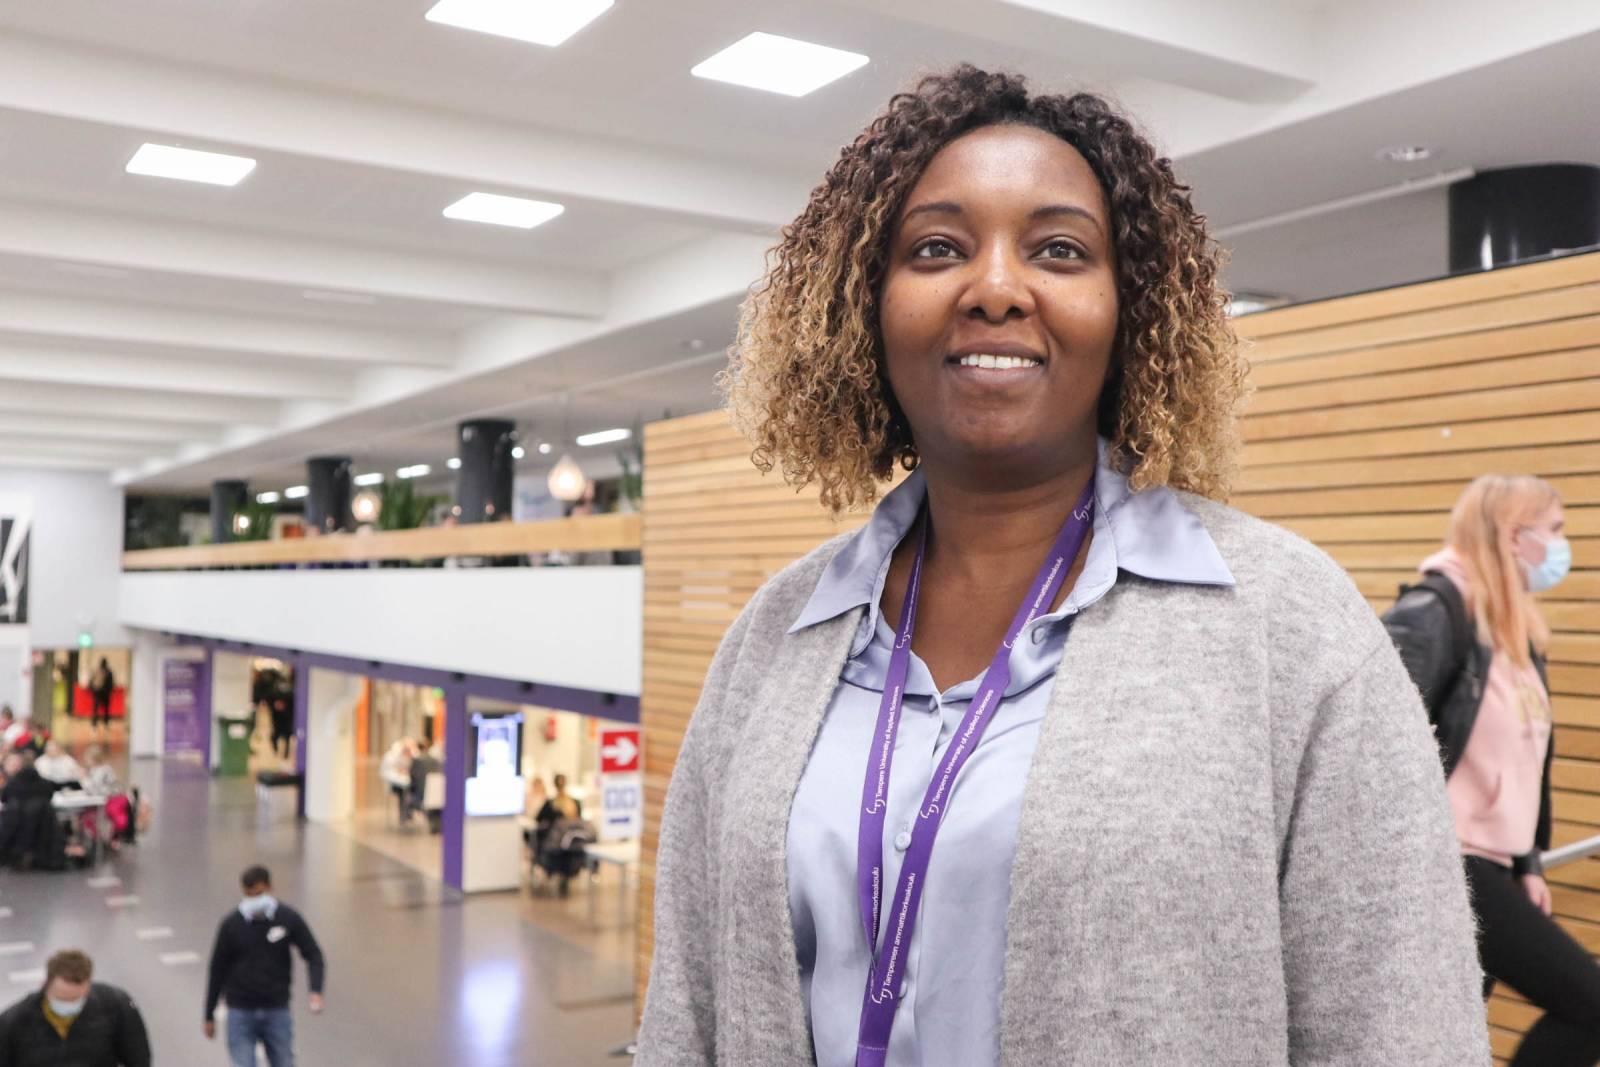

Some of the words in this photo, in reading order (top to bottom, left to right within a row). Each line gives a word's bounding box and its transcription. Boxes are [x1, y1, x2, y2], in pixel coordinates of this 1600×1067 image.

[890, 686, 899, 711] Sciences
[886, 711, 895, 733] Applied
[879, 740, 891, 770] University
[932, 774, 949, 802] Tampere
[945, 744, 964, 774] University
[960, 736, 967, 744] of
[964, 715, 980, 738] Applied
[975, 689, 994, 716] Sciences
[876, 770, 885, 798] Tampere
[883, 945, 899, 986] Tampereen
[894, 872, 916, 945] ammattikorkeakoulu
